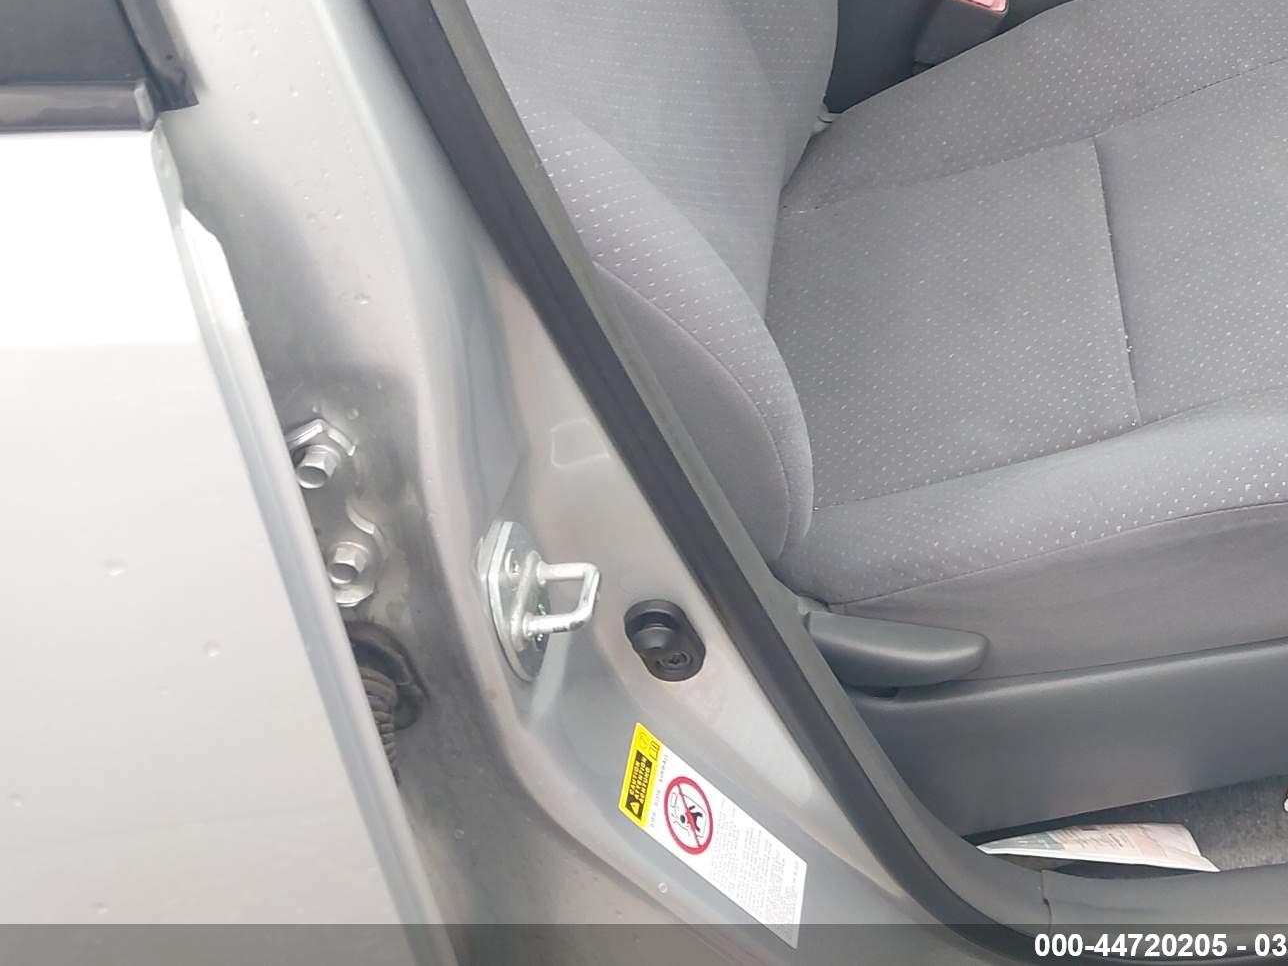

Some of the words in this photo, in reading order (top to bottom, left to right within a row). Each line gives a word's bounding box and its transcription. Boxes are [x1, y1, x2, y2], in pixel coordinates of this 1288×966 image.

[628, 760, 641, 795] CAUTION
[634, 755, 648, 801] ATTENTION
[639, 765, 651, 804] ACHTUNG
